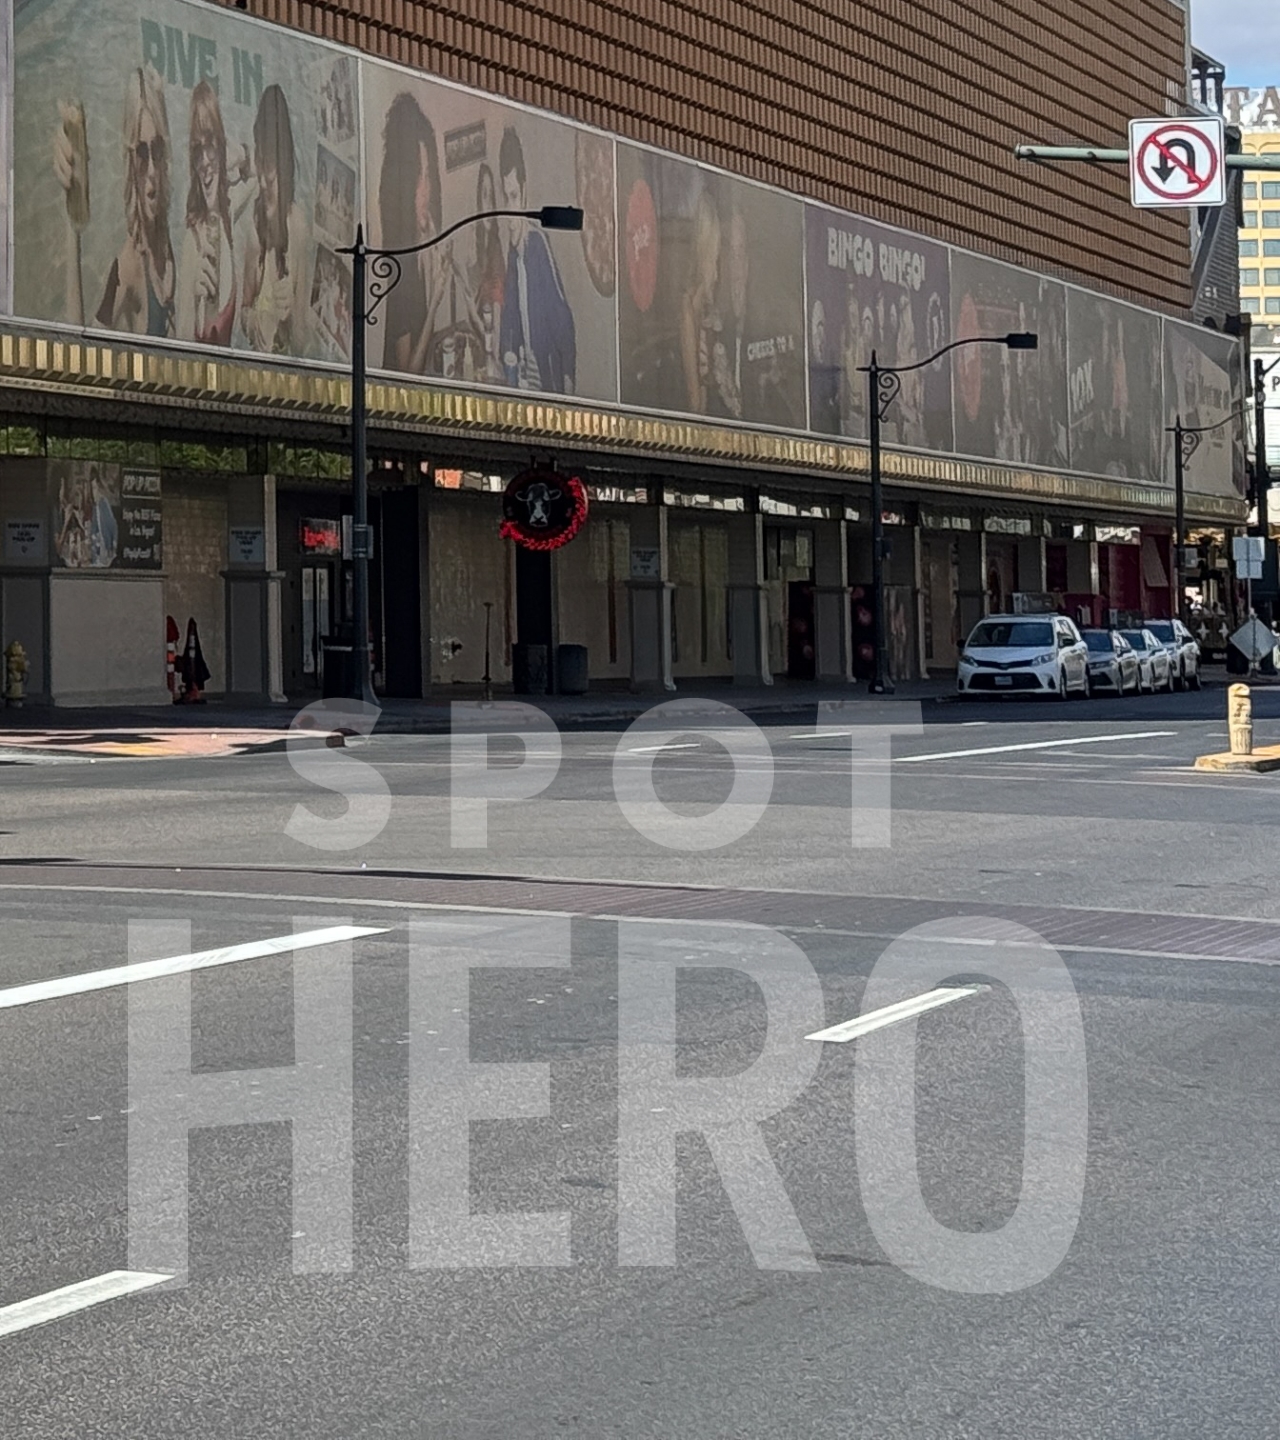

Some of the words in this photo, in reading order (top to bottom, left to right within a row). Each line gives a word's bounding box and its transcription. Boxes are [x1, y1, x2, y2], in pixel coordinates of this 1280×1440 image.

[141, 17, 219, 89] DIVE
[231, 46, 264, 107] IN
[827, 226, 874, 278] BINGO
[879, 242, 926, 291] BINGO!
